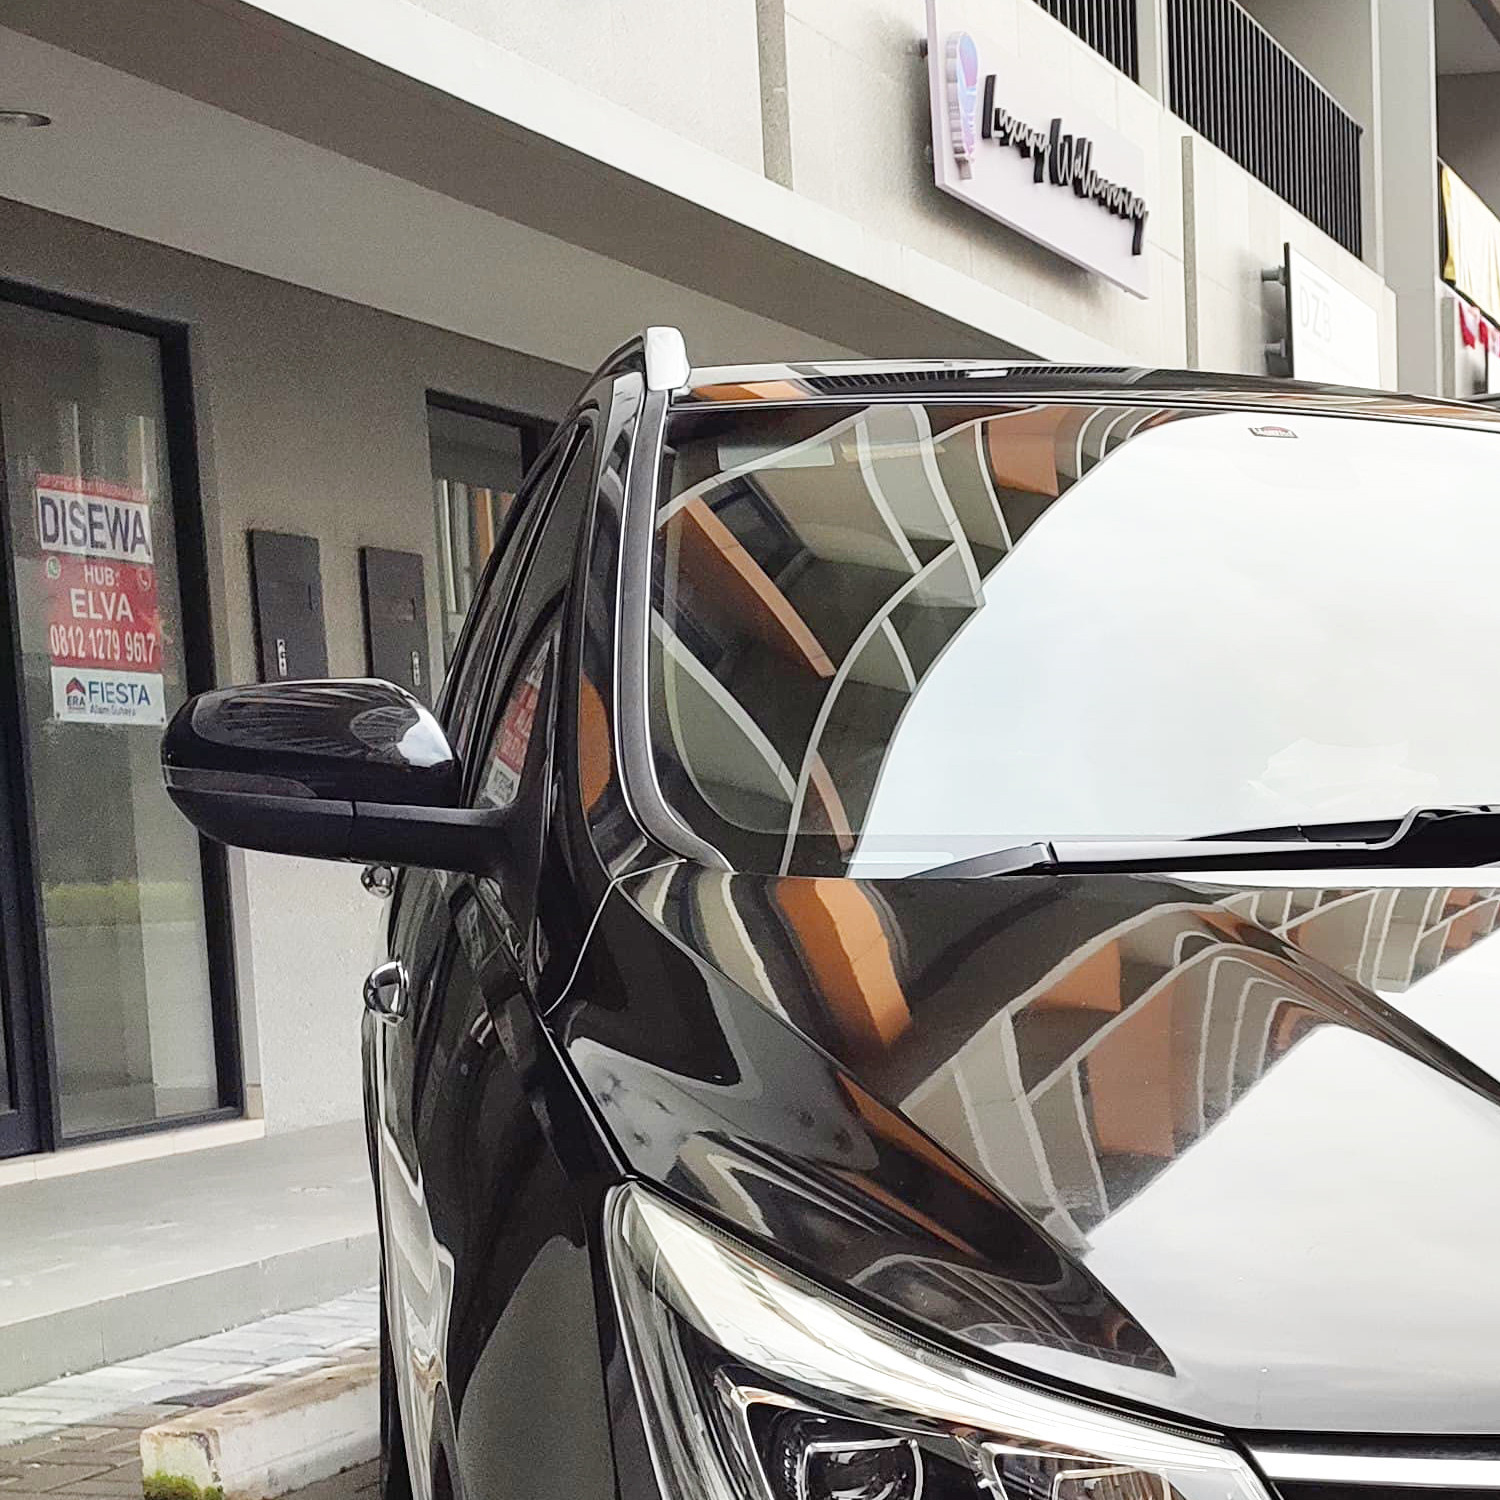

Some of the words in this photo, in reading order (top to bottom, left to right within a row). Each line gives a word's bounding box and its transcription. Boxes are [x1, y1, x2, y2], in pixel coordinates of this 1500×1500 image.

[40, 496, 151, 556] DISEWA
[84, 564, 120, 587] HUB:
[70, 588, 134, 622] ELVA
[50, 624, 86, 657] 0812
[89, 628, 121, 661] 1279
[88, 680, 151, 706] FIESTA
